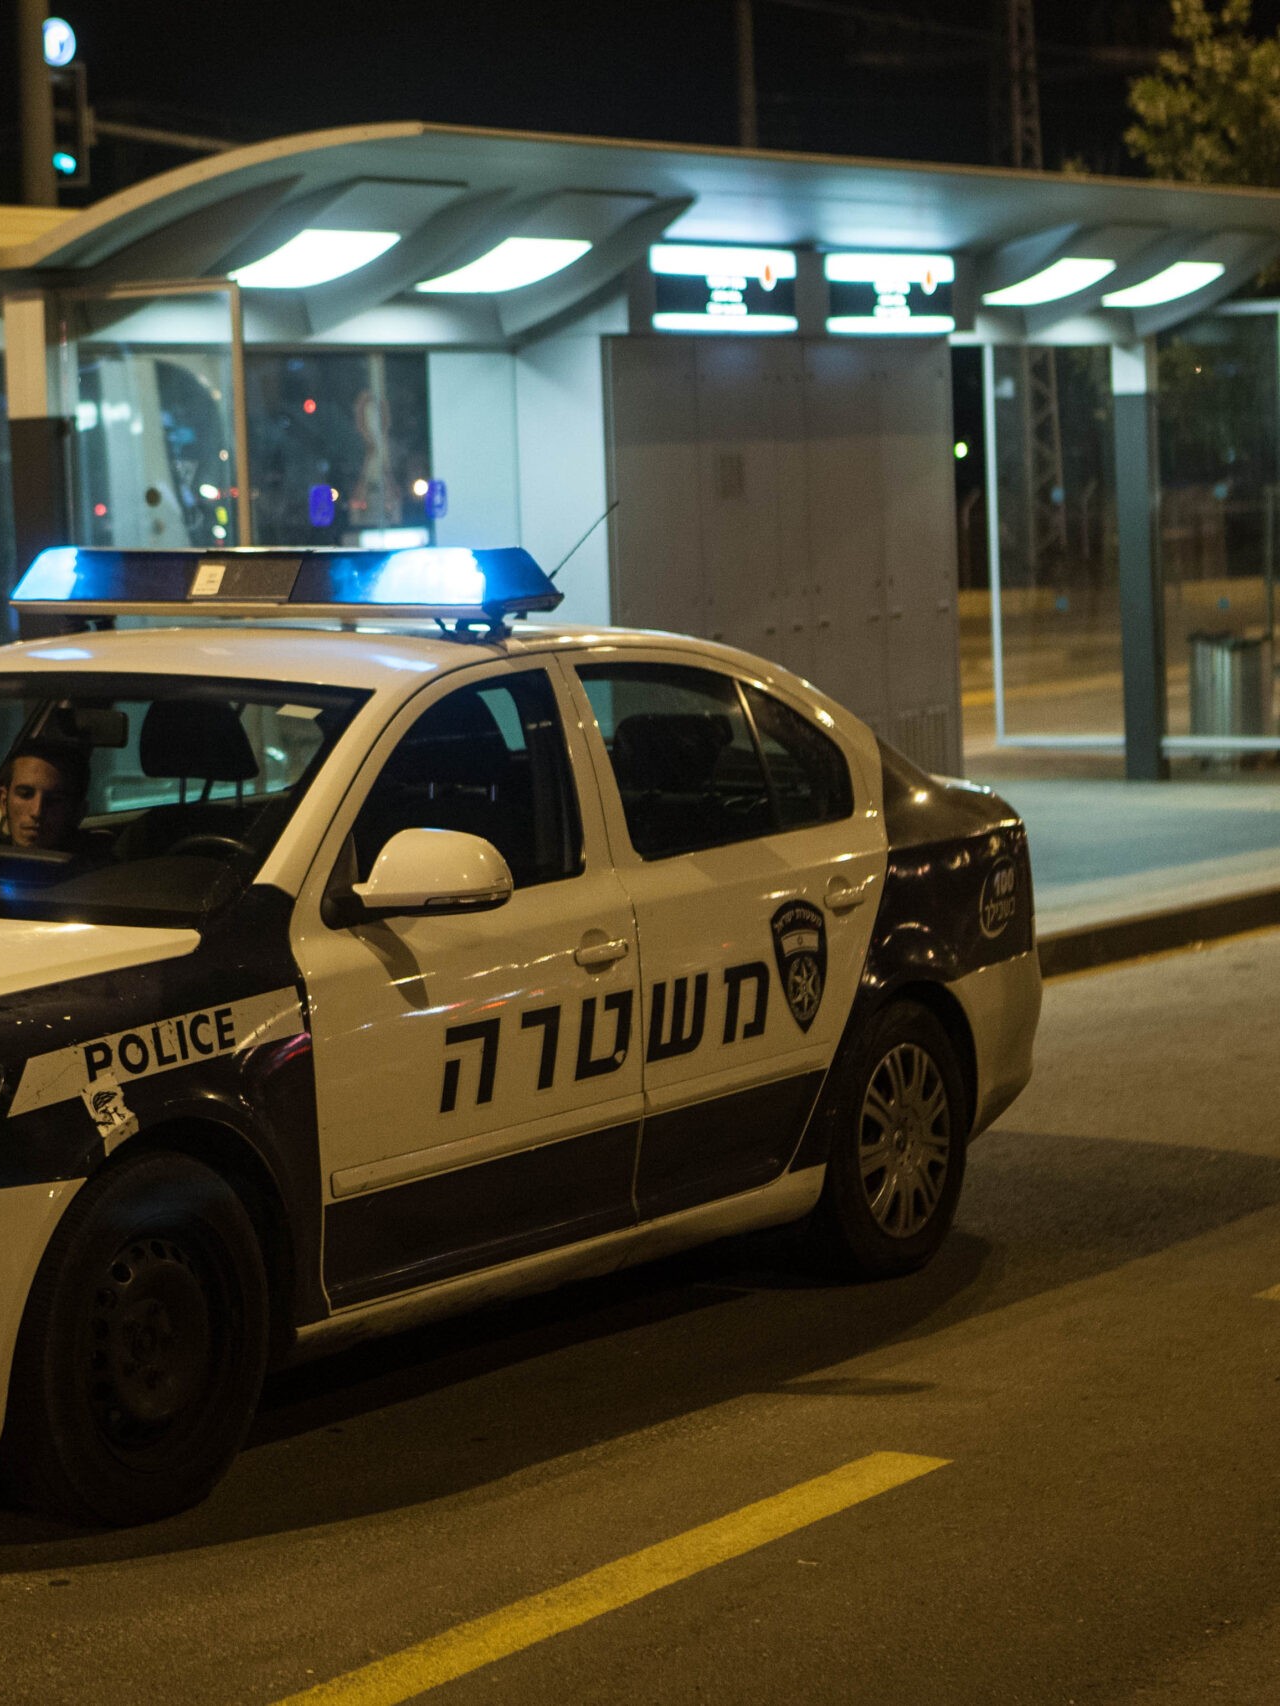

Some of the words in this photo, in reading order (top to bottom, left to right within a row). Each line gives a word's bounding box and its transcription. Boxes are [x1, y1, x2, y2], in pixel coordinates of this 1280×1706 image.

[994, 867, 1015, 897] 100
[83, 1007, 236, 1084] POLICE
[439, 961, 770, 1113] משטרה
